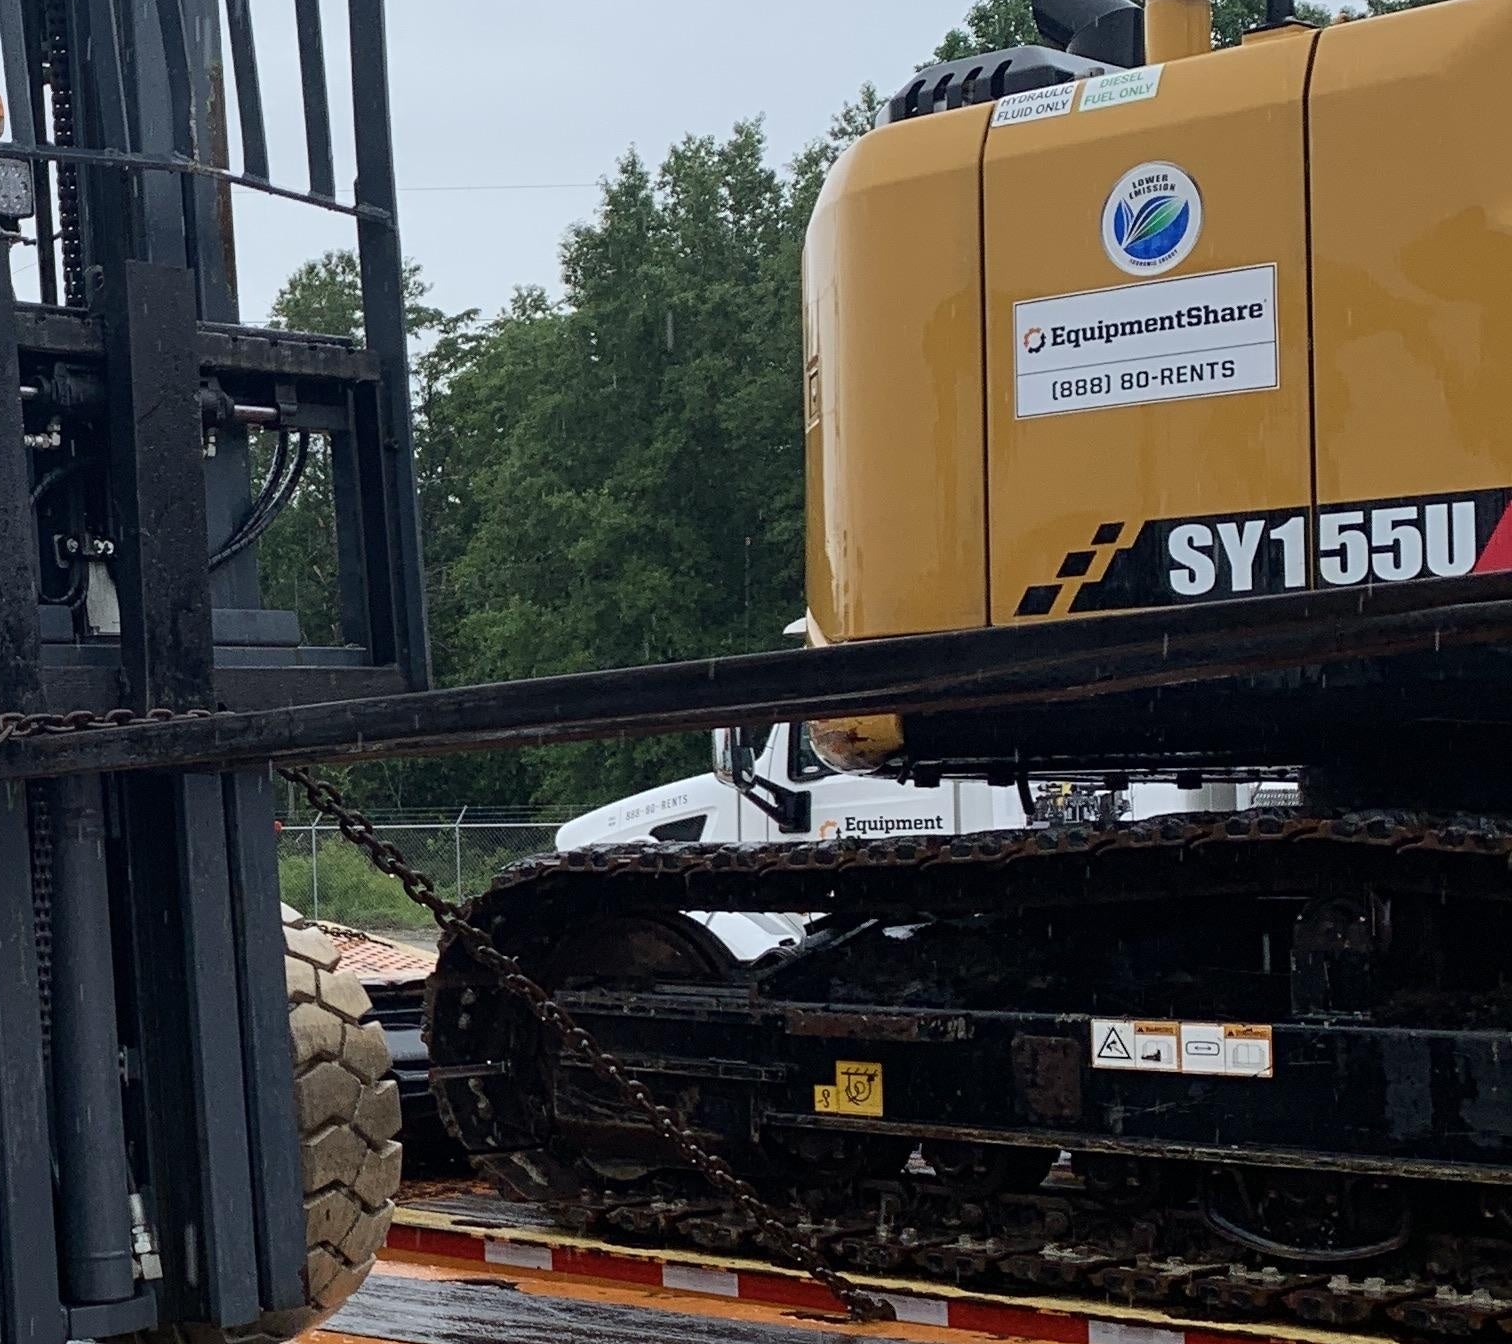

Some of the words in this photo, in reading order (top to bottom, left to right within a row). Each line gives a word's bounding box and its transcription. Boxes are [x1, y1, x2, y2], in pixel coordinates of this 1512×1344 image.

[1100, 72, 1144, 88] DIESEL
[1001, 84, 1073, 106] HYDRAULIC
[1084, 92, 1115, 106] FUEL
[1120, 82, 1154, 98] ONLY
[996, 106, 1033, 122] FLUID
[1036, 99, 1069, 115] ONLY
[1128, 183, 1176, 200] EMISSION
[1131, 173, 1169, 189] LOWER
[1050, 302, 1264, 348] EquipmentShare
[1051, 374, 1111, 401] (888)
[1120, 360, 1235, 391] 80-RENTS
[1168, 500, 1477, 596] SY155U
[844, 815, 944, 834] Equipment
